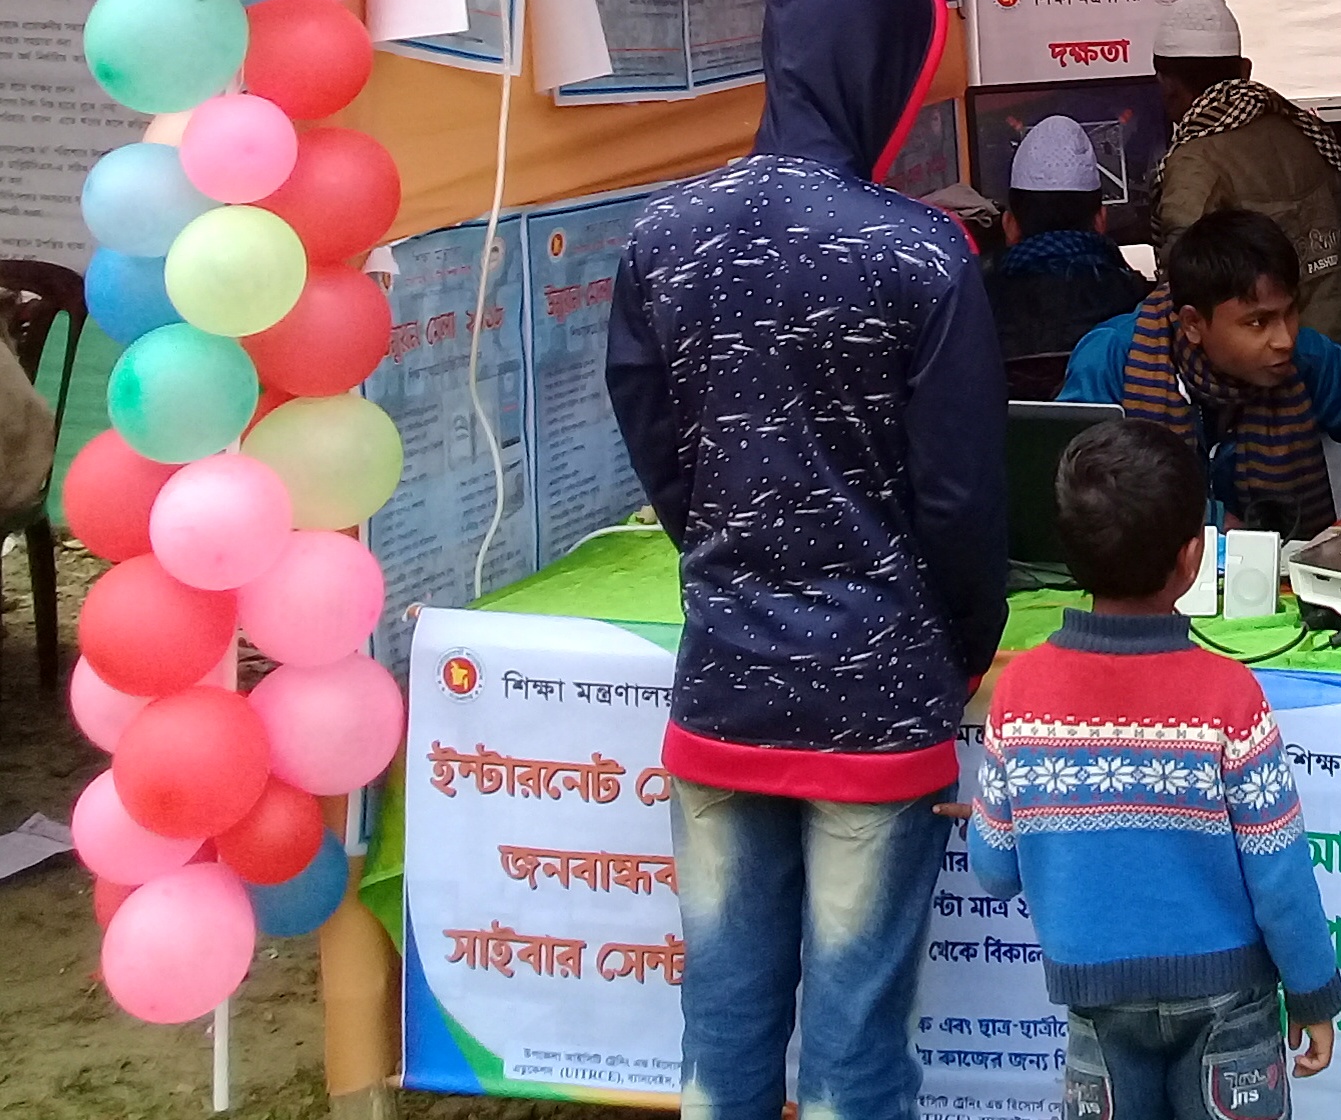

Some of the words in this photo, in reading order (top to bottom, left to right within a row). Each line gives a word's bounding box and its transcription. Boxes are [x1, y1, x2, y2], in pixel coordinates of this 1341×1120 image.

[1048, 39, 1131, 68] দক্ষতা
[502, 670, 565, 702] শিক্ষা
[426, 740, 626, 804] ইন্টারনেট
[443, 919, 588, 980] সাইবার
[939, 1017, 972, 1036] এবং
[937, 1049, 1003, 1070] কাজের
[1007, 1052, 1050, 1071] জন্য
